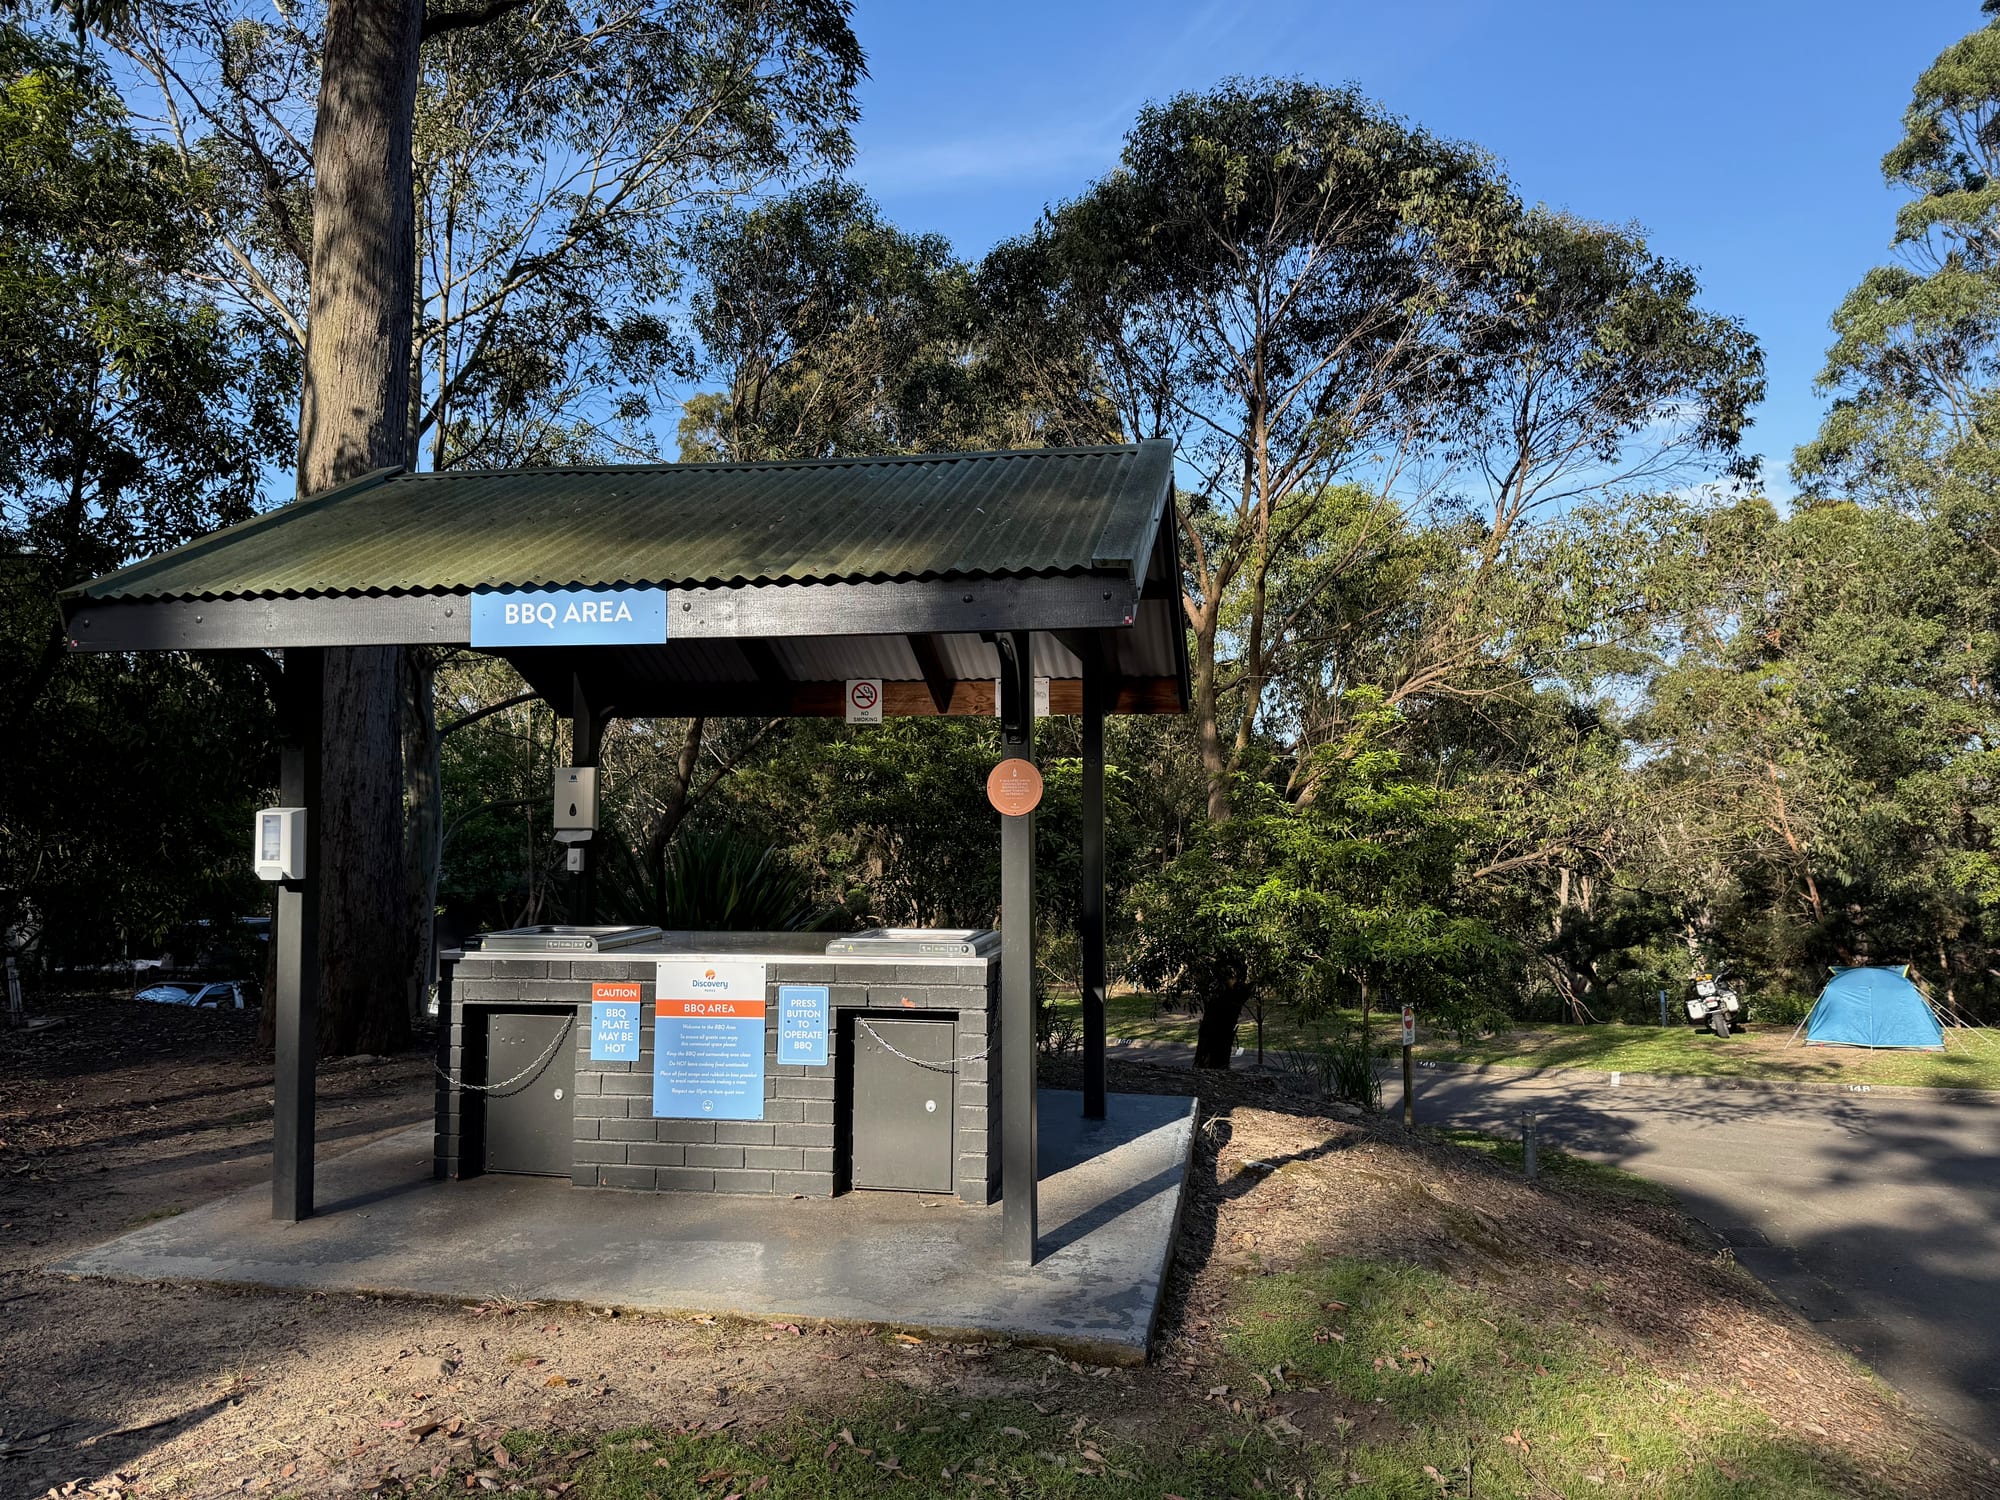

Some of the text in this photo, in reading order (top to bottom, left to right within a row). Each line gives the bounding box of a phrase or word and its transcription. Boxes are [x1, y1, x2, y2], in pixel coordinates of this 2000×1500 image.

[505, 601, 632, 629] BBQ AREA
[692, 980, 728, 990] Discovery
[596, 988, 637, 998] CAUTION
[684, 1004, 735, 1014] BBQ AREA
[791, 1000, 817, 1008] PRESS
[606, 1008, 626, 1019] BBQ
[786, 1010, 821, 1018] BUTTON
[602, 1020, 630, 1030] PLATE
[598, 1032, 634, 1041] MAY BE
[784, 1030, 823, 1039] OPERATE
[605, 1044, 626, 1053] HOT
[794, 1041, 813, 1052] BBQ
